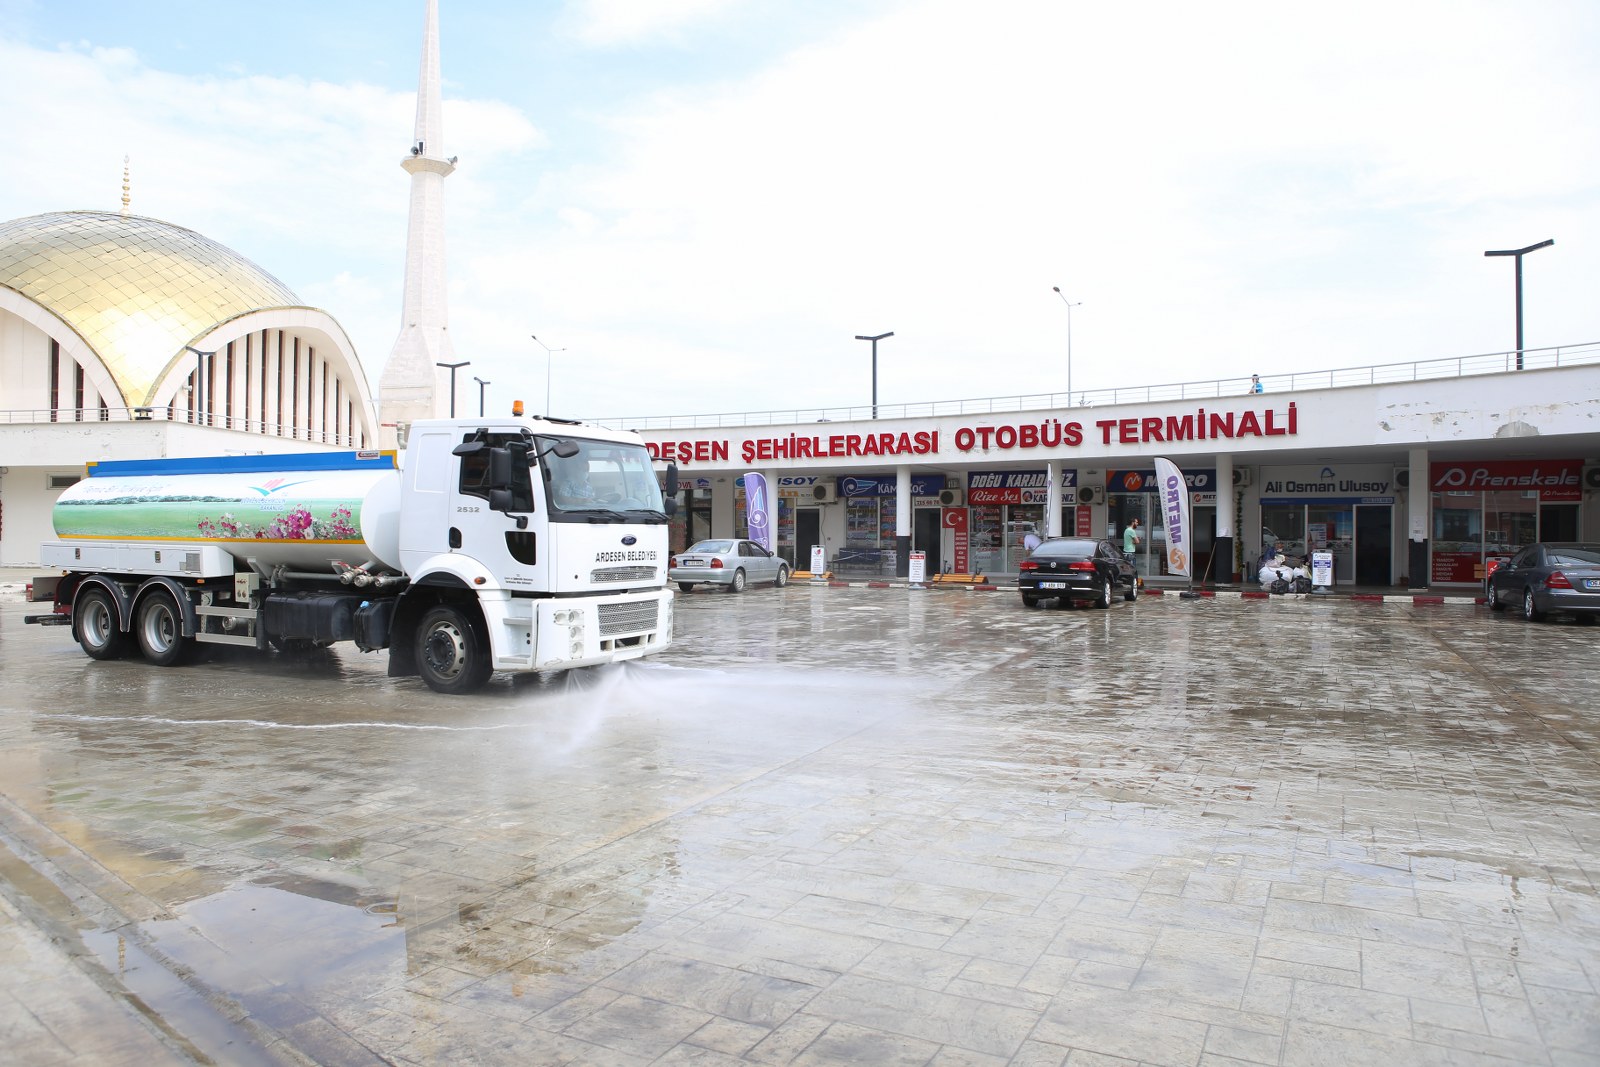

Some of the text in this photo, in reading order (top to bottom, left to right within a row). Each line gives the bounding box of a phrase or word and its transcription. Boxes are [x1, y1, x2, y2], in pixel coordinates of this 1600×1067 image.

[645, 402, 1298, 465] DEŞEN ŞEHİRLERARASI OTOBÜS TERMİNALİ
[970, 473, 1003, 488] DOĞU
[1144, 474, 1208, 487] MRO
[1469, 467, 1580, 487] Prenskale
[910, 483, 925, 495] OÇ
[1264, 480, 1389, 494] Ali Osman Ulusoy
[970, 490, 999, 502] Rize
